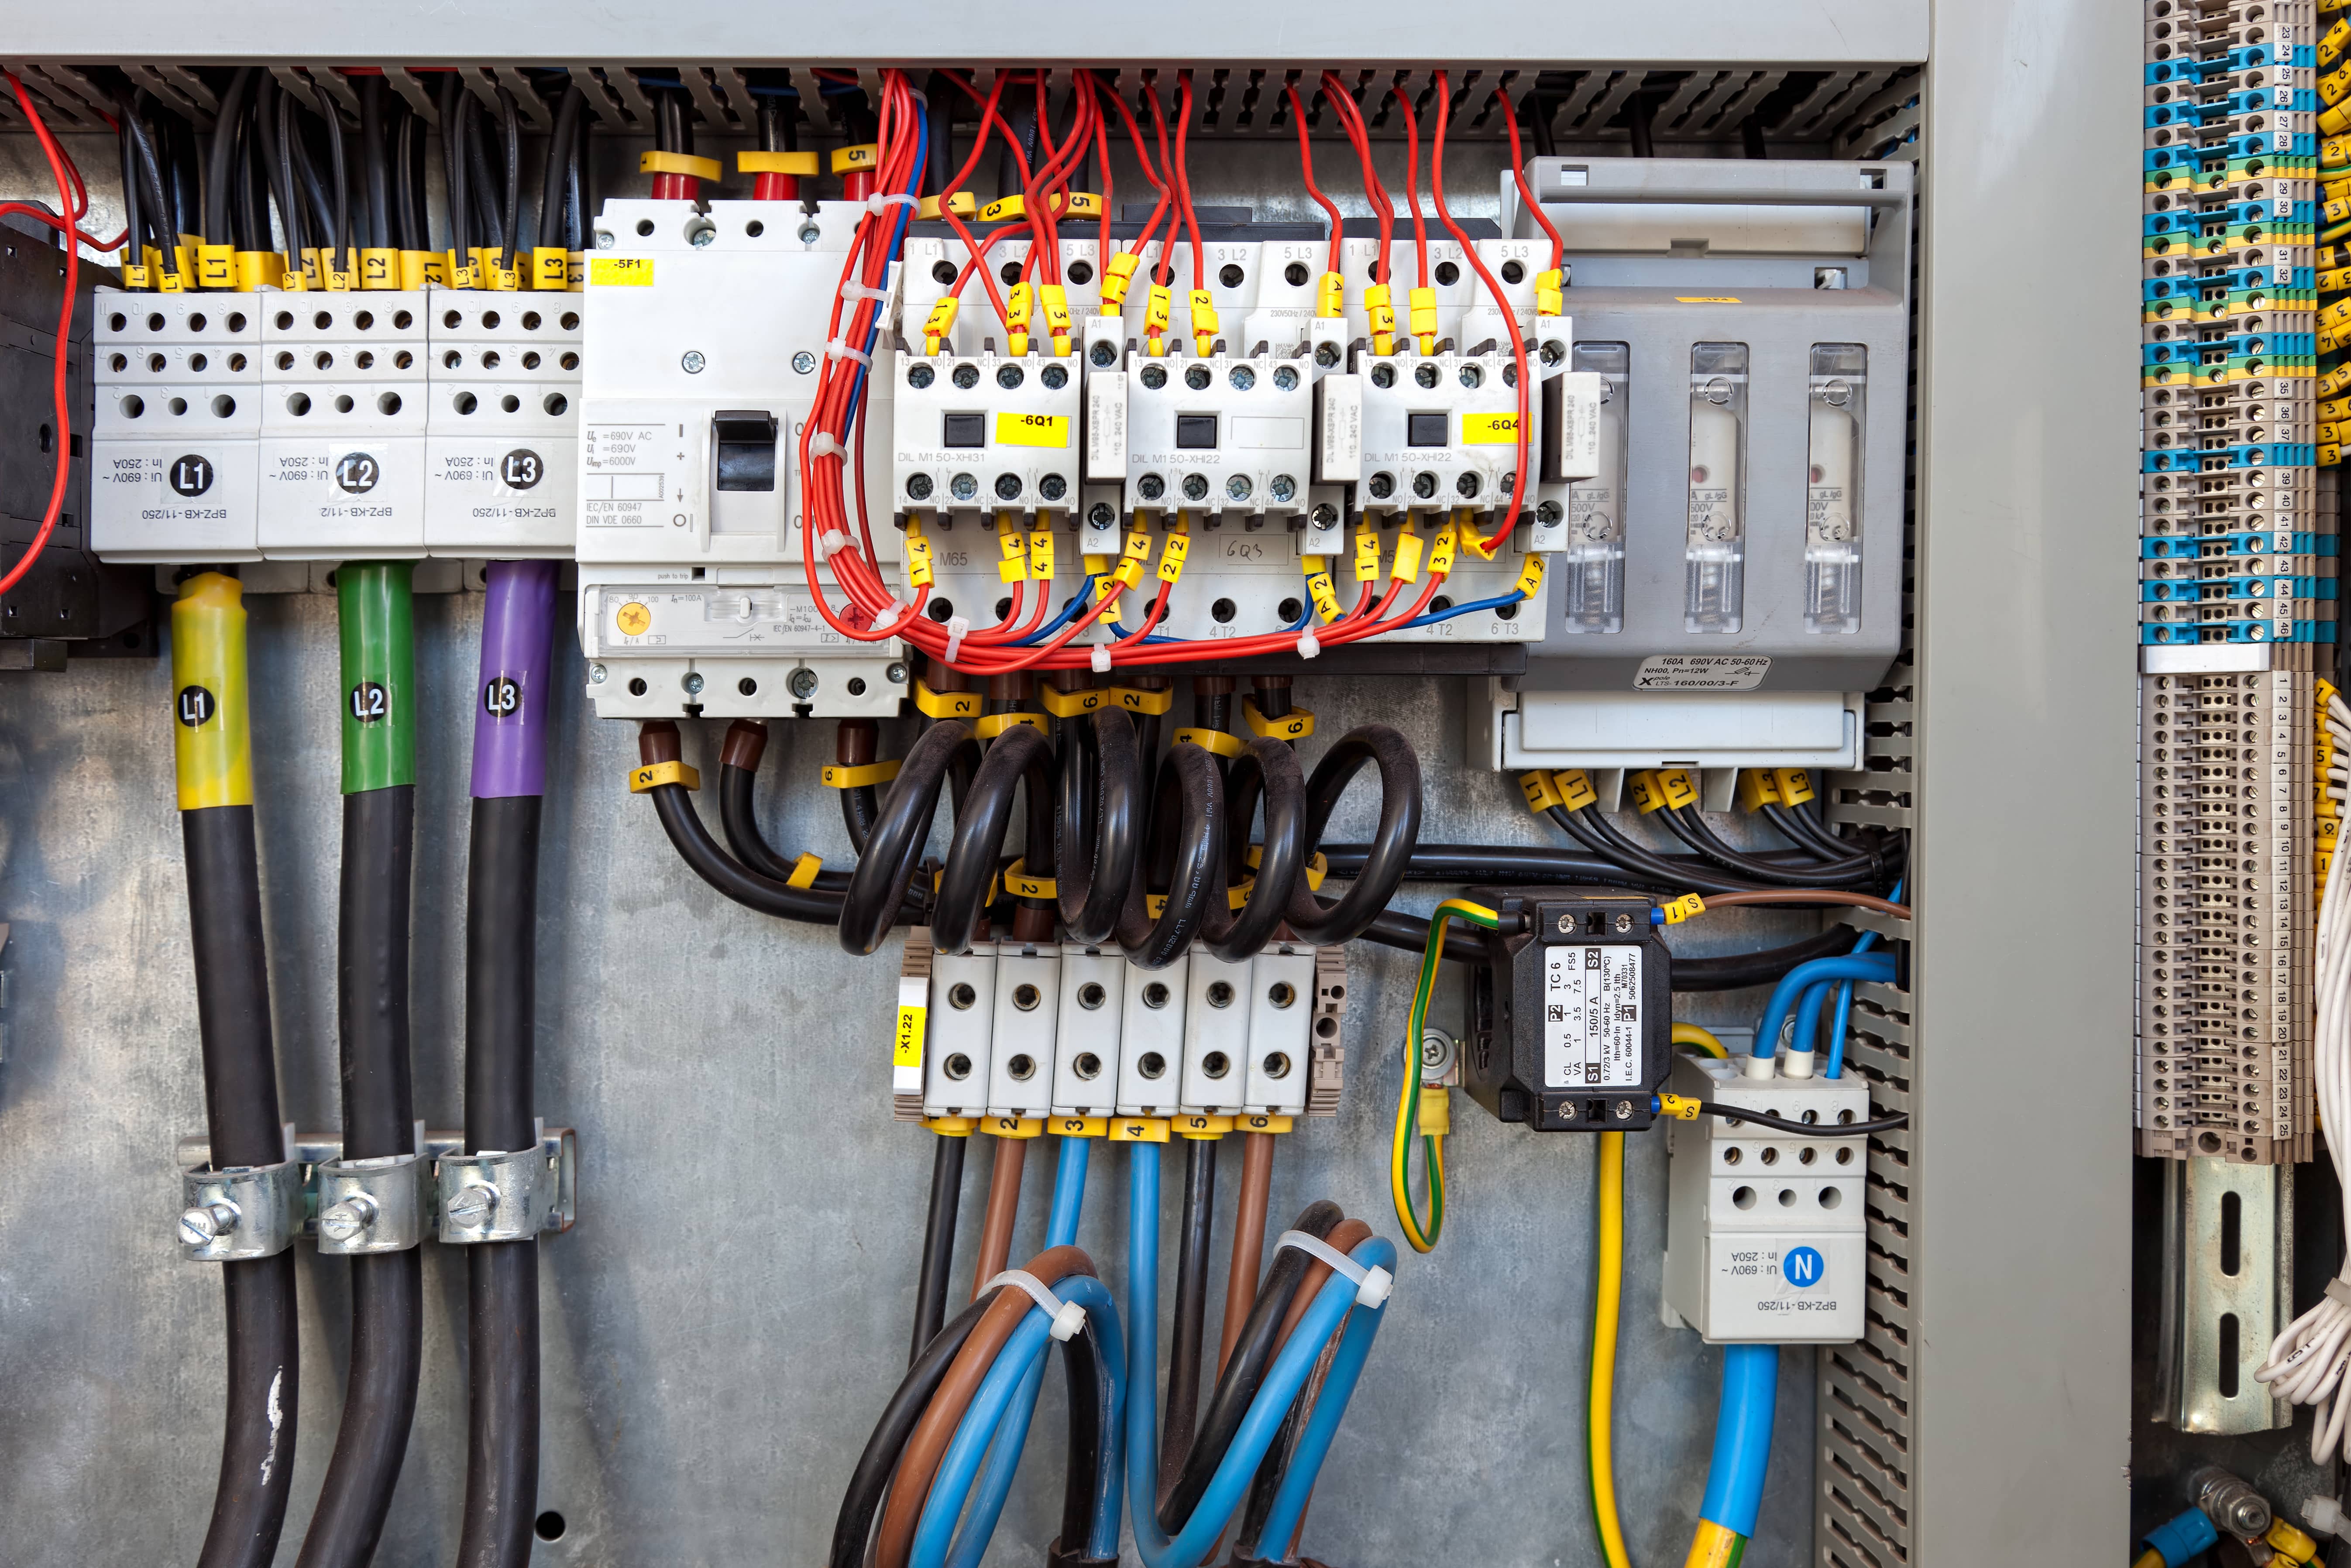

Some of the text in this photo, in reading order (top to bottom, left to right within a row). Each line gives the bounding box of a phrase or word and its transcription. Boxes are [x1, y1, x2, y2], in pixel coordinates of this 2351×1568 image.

[2282, 45, 2290, 56] 24
[2282, 68, 2290, 80] 25
[2280, 90, 2288, 103] 26
[2279, 135, 2288, 147] 28
[848, 150, 866, 161] 5
[1071, 196, 1090, 207] 5
[2280, 201, 2288, 213] 30
[986, 204, 1001, 217] 3
[1066, 244, 1094, 255] 5 L3
[1217, 248, 1247, 261] 3 L2
[1284, 247, 1312, 259] 5 L3
[206, 259, 227, 278] L1
[366, 258, 386, 279] L2
[544, 258, 564, 279] L3
[614, 259, 640, 268] -5F1
[132, 266, 145, 281] L1
[456, 269, 470, 285] L3
[2279, 269, 2288, 281] 32
[333, 274, 345, 290] L2
[1009, 309, 1021, 319] 3
[1091, 319, 1101, 329] A1
[2281, 407, 2289, 419] 36
[1021, 415, 1053, 427] -6Q1
[638, 431, 652, 440] AC
[898, 453, 914, 462] DIL
[1132, 454, 1148, 463] DIL
[343, 460, 372, 487] L2
[507, 456, 536, 482] L3
[180, 463, 203, 489] L1
[2282, 473, 2290, 485] 39
[899, 495, 1076, 505] 14 NO 22 NC 34 NO 44 NO
[587, 501, 642, 514] IEC/EN 60947
[586, 515, 642, 524] DIN VDE 0660
[2281, 516, 2289, 526] 41
[1034, 538, 1048, 548] 4
[1087, 538, 1098, 547] A2
[1170, 540, 1184, 551] 2
[940, 552, 967, 566] M65
[2280, 560, 2289, 572] 43
[2279, 603, 2288, 614] 45
[2280, 622, 2289, 634] 46
[354, 688, 384, 716] L2
[488, 684, 515, 710] L3
[183, 693, 205, 719] L1
[1567, 776, 1588, 799] L1
[1669, 774, 1691, 799] L2
[1791, 772, 1810, 794] L3
[2279, 861, 2288, 871] 11
[2280, 916, 2288, 928] 14
[1551, 974, 1560, 991] TC
[2278, 973, 2286, 985] 17
[1550, 1005, 1561, 1021] P2
[1604, 1003, 1610, 1013] Hz
[1623, 1007, 1634, 1021] P1
[1587, 951, 1598, 1081] S1 150/5 A S2
[2278, 1009, 2287, 1021] 19
[901, 1014, 913, 1053] -X1.22
[1604, 1045, 1610, 1054] kV
[2279, 1050, 2287, 1060] 21
[1564, 1062, 1571, 1076] CL
[1574, 1062, 1581, 1075] VA
[2279, 1087, 2288, 1100] 23
[1000, 1117, 1019, 1130] 2
[1065, 1119, 1084, 1132] 3
[1190, 1117, 1207, 1129] 5
[1127, 1125, 1145, 1137] 4
[2280, 1124, 2288, 1136] 25
[1731, 1252, 1758, 1262] 250A
[1768, 1252, 1777, 1261] In
[1731, 1265, 1757, 1275] 690V
[1767, 1265, 1777, 1275] Ui
[1795, 1254, 1812, 1280] N
